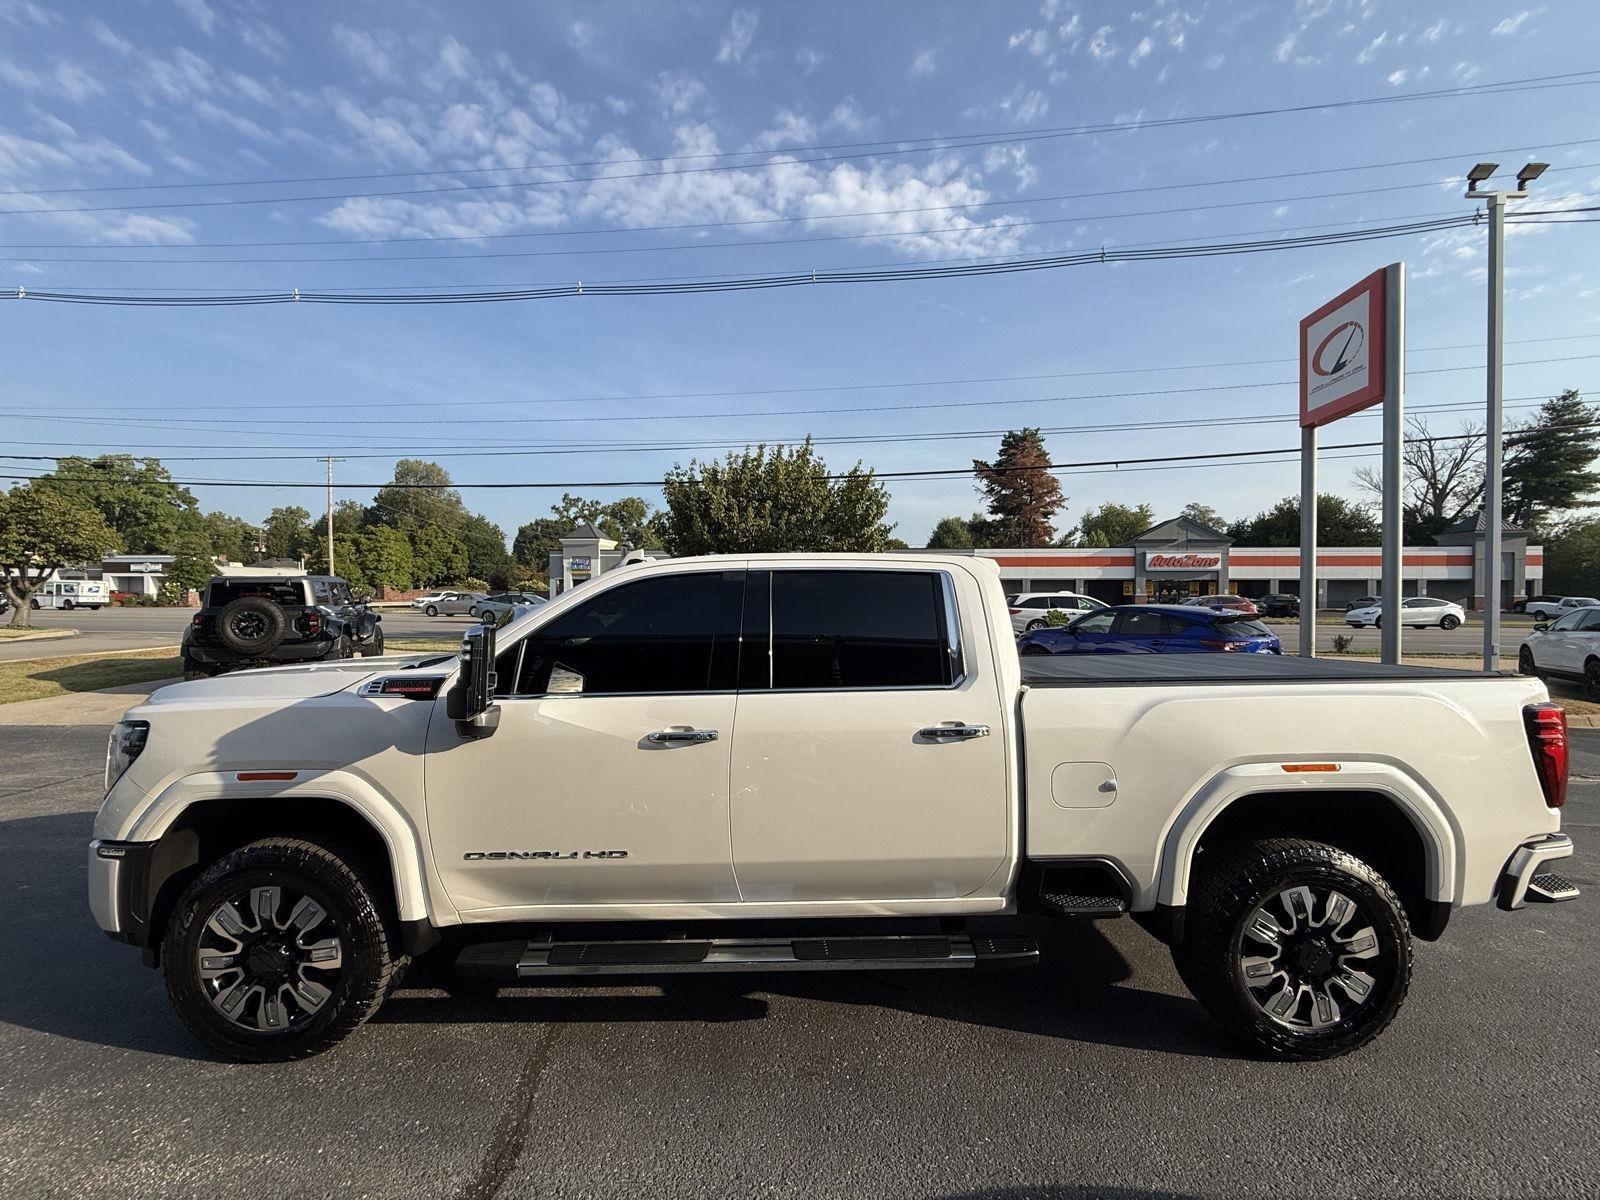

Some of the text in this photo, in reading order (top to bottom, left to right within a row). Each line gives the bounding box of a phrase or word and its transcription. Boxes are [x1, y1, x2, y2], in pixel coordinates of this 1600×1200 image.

[1148, 555, 1220, 568] AutoZone
[463, 851, 628, 860] DENALI HD
